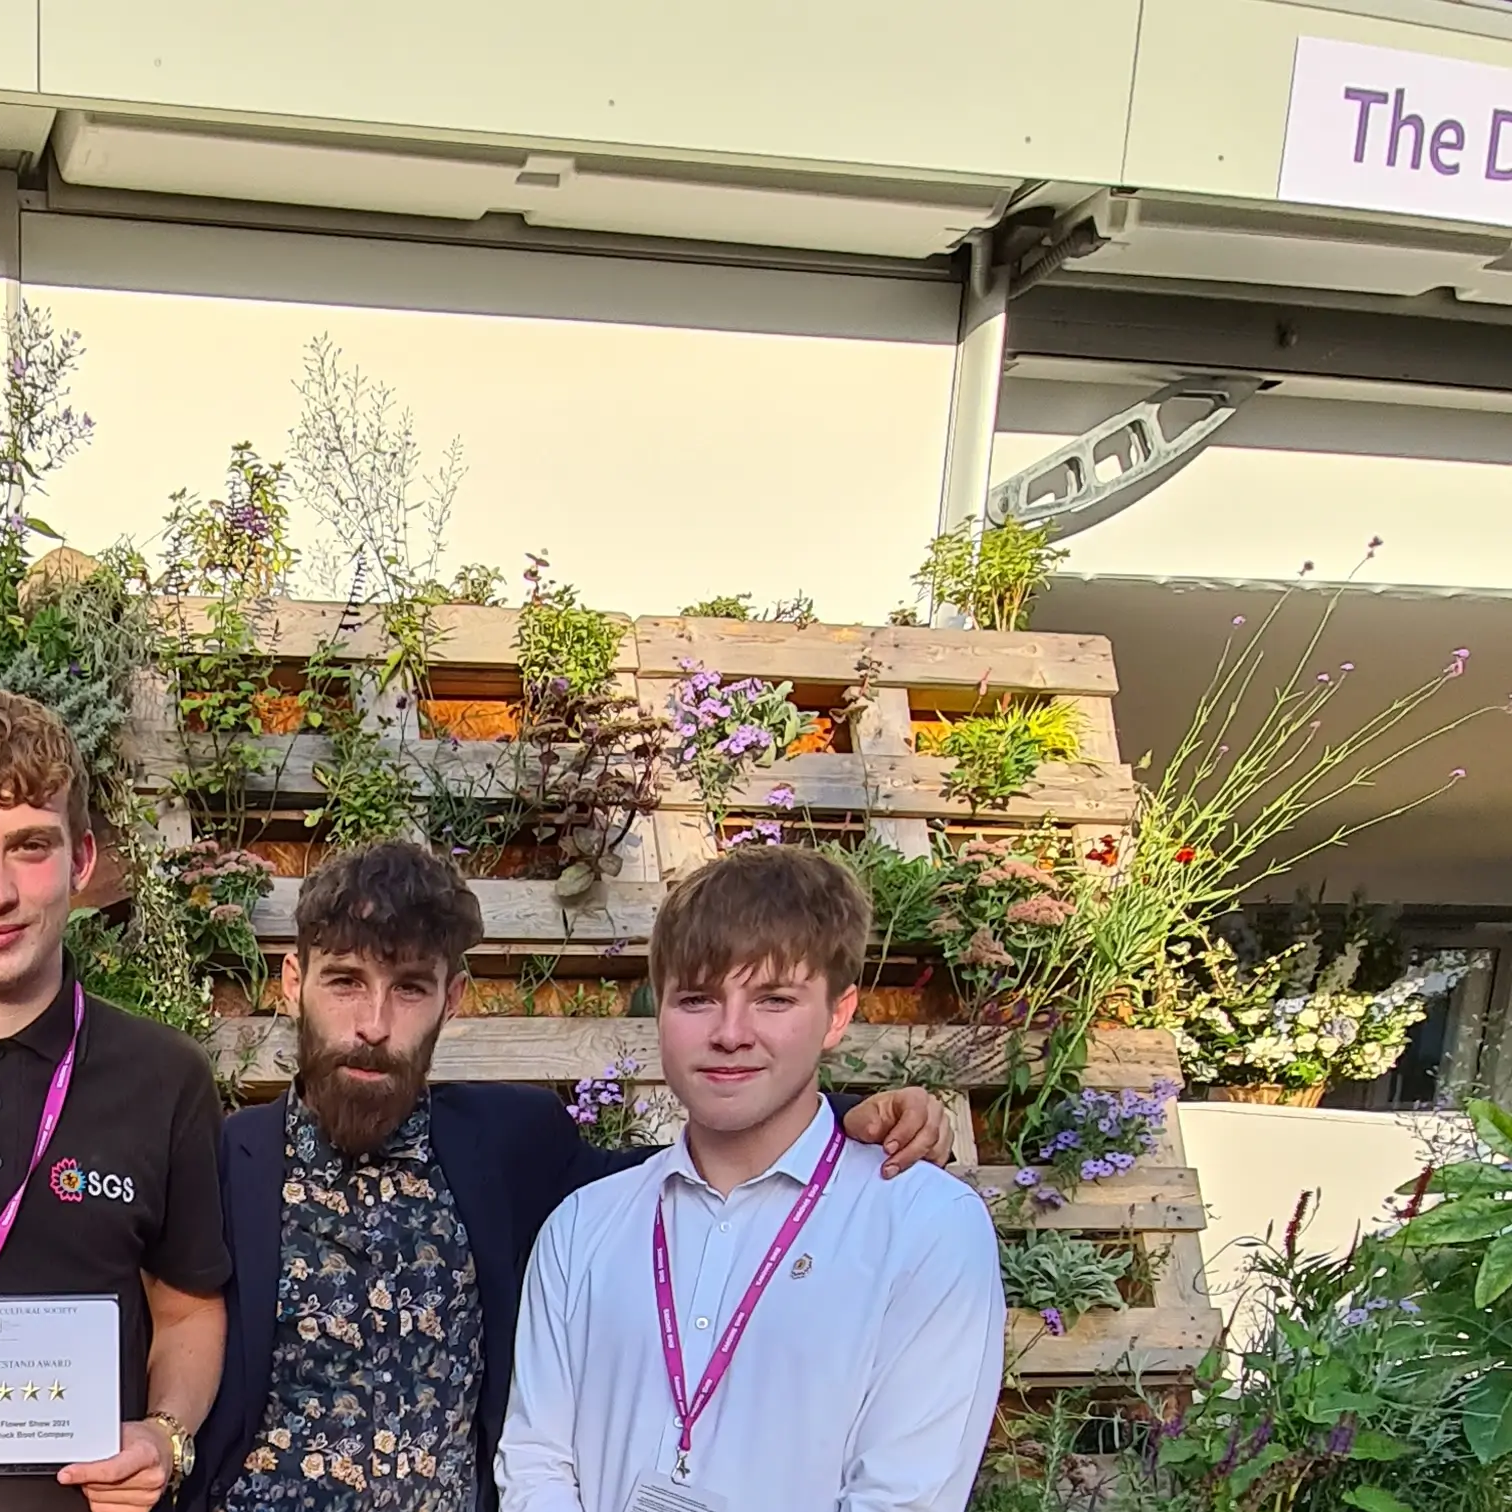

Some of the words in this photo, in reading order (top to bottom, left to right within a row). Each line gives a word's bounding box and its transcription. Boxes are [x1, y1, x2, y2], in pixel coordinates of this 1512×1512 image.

[1343, 86, 1465, 176] The
[88, 1171, 135, 1203] SGS
[43, 1307, 78, 1315] SOCIETY
[37, 1359, 72, 1368] AWARD
[0, 1419, 27, 1428] Flower
[29, 1419, 50, 1427] Show
[52, 1419, 70, 1427] 2021
[16, 1431, 36, 1439] Boot
[37, 1430, 74, 1440] Company
